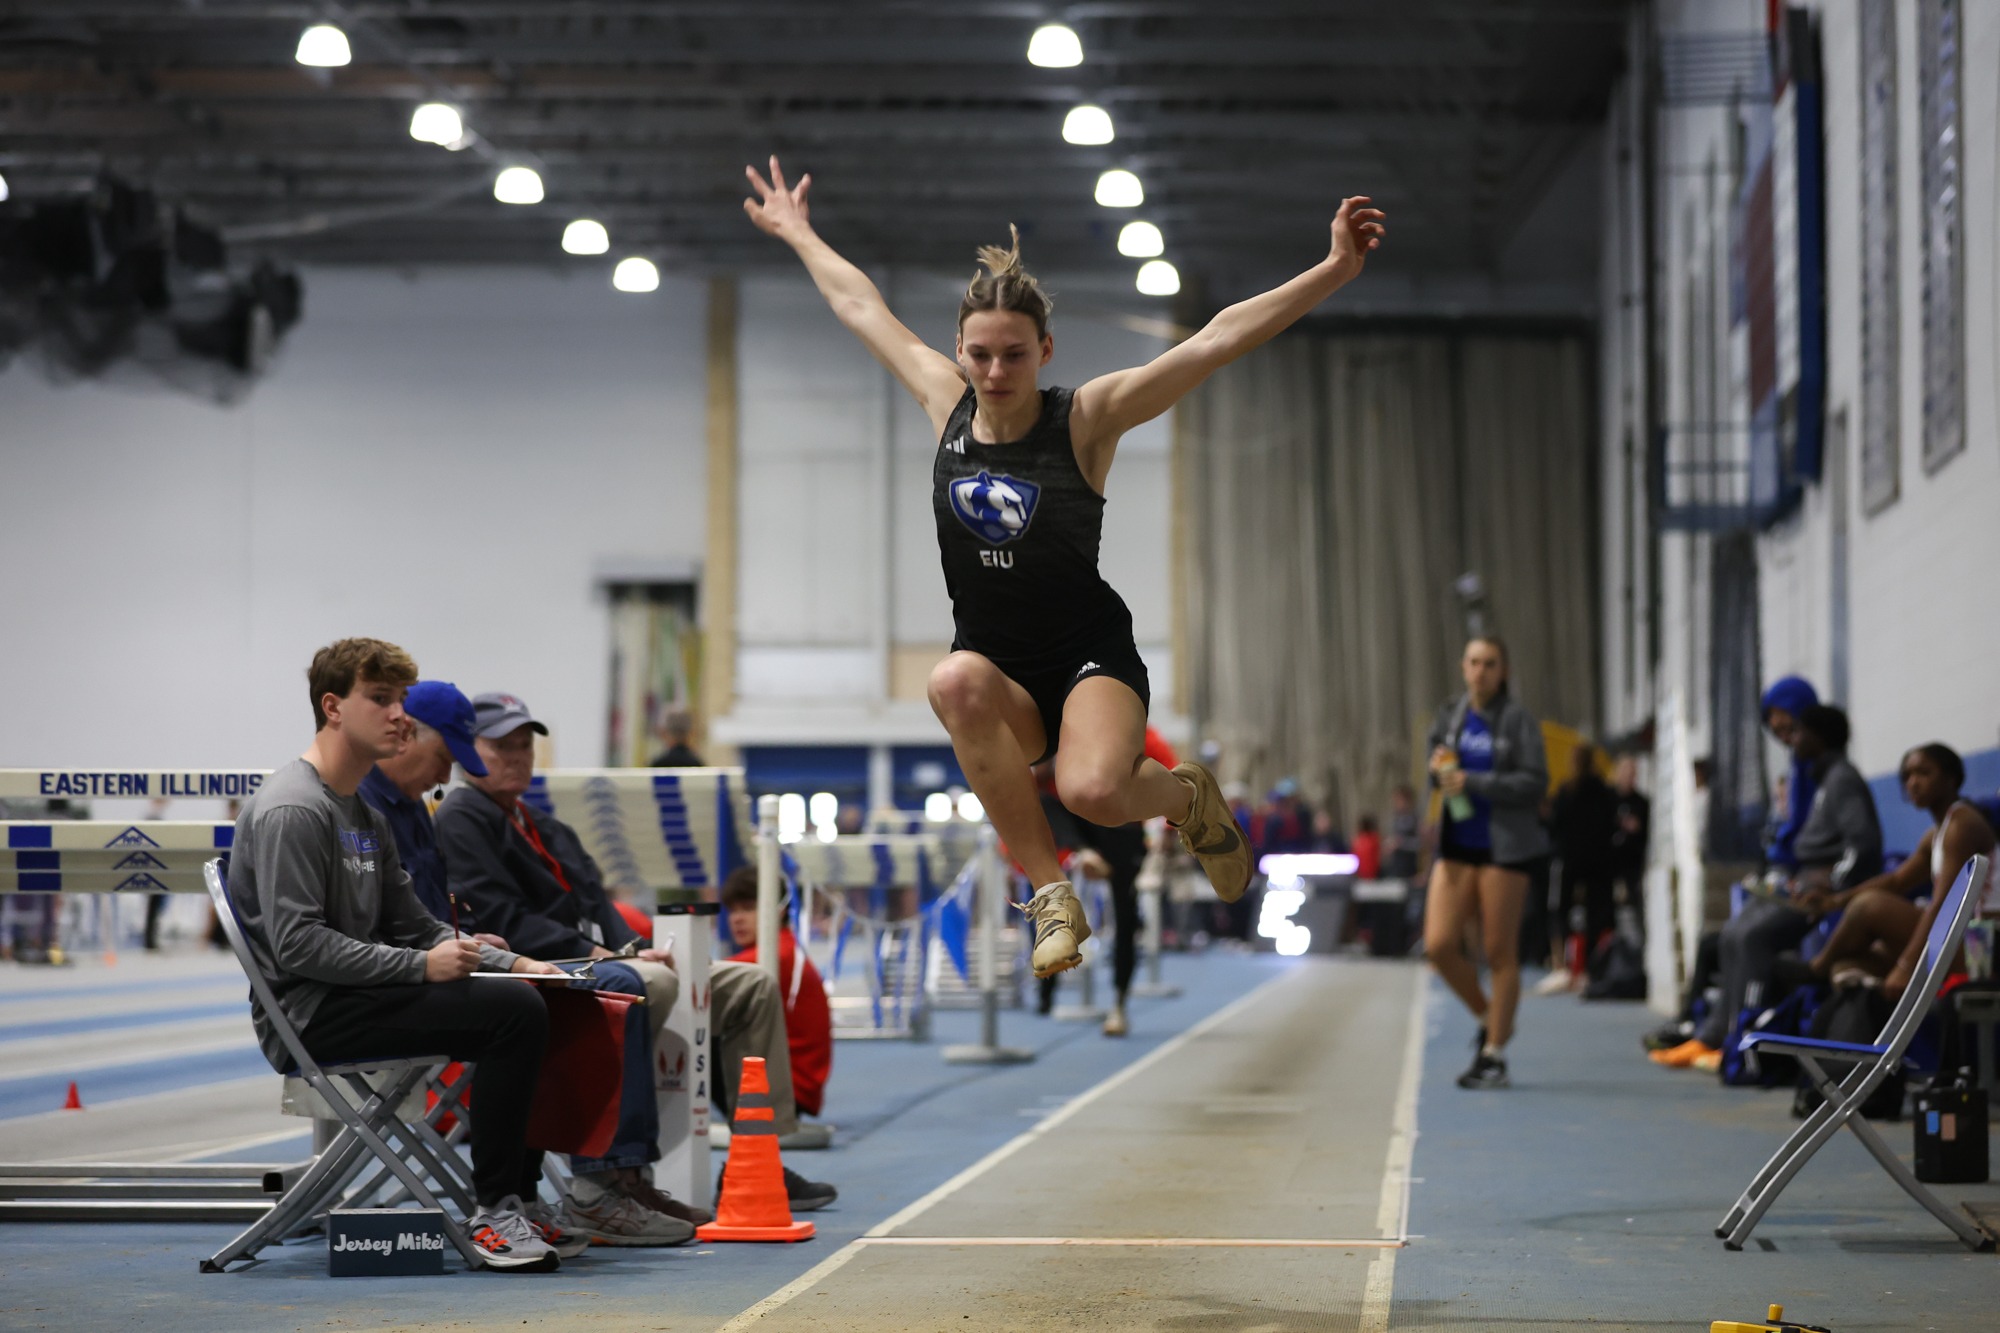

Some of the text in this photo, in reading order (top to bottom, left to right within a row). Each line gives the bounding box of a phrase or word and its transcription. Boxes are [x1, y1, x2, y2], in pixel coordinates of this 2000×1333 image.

[979, 550, 1014, 569] EIU
[40, 773, 149, 796] EASTERN
[695, 1027, 706, 1098] USA
[333, 1233, 393, 1256] Jersey
